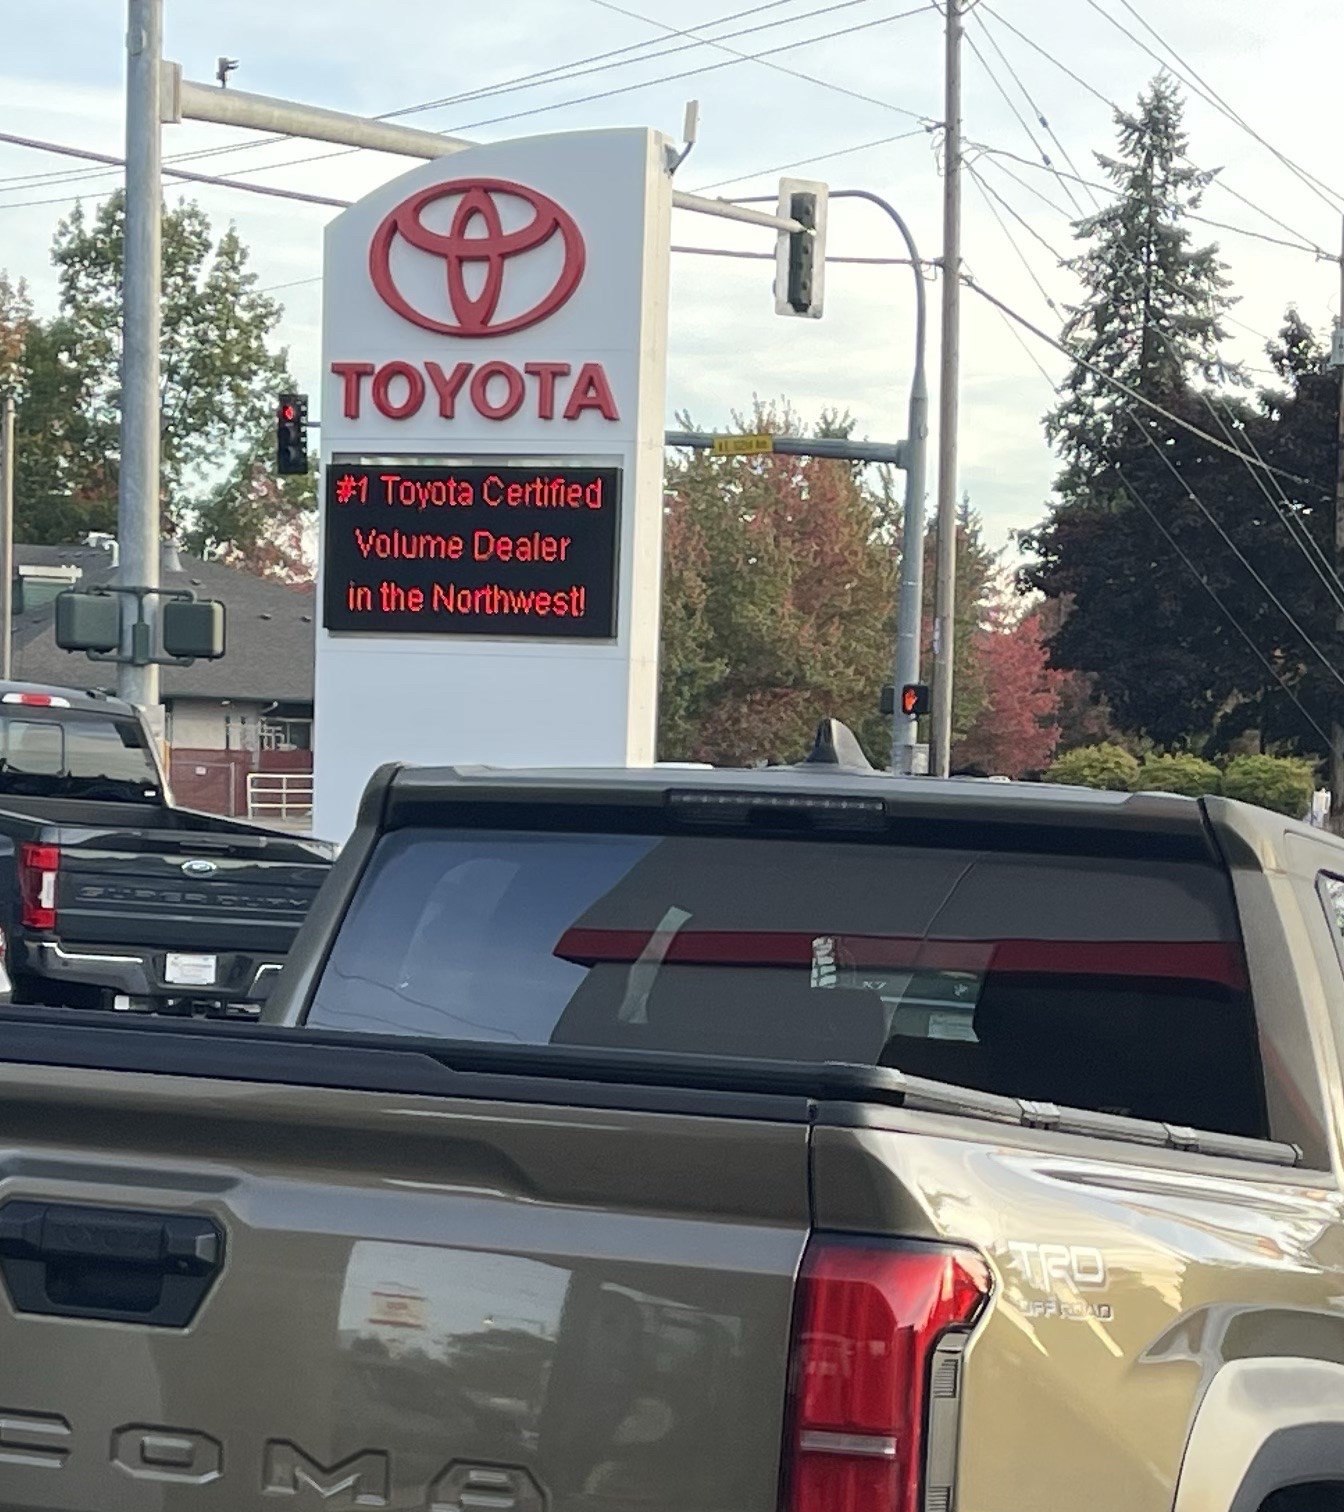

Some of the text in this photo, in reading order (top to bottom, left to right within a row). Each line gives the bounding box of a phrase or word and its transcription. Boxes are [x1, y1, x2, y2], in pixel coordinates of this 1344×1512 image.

[330, 360, 620, 420] TOYOTA
[336, 474, 603, 511] #1 Toyota Certified
[354, 528, 572, 562] Volume Dealer
[347, 580, 587, 618] in the Northwest!
[1006, 1240, 1105, 1295] TRD
